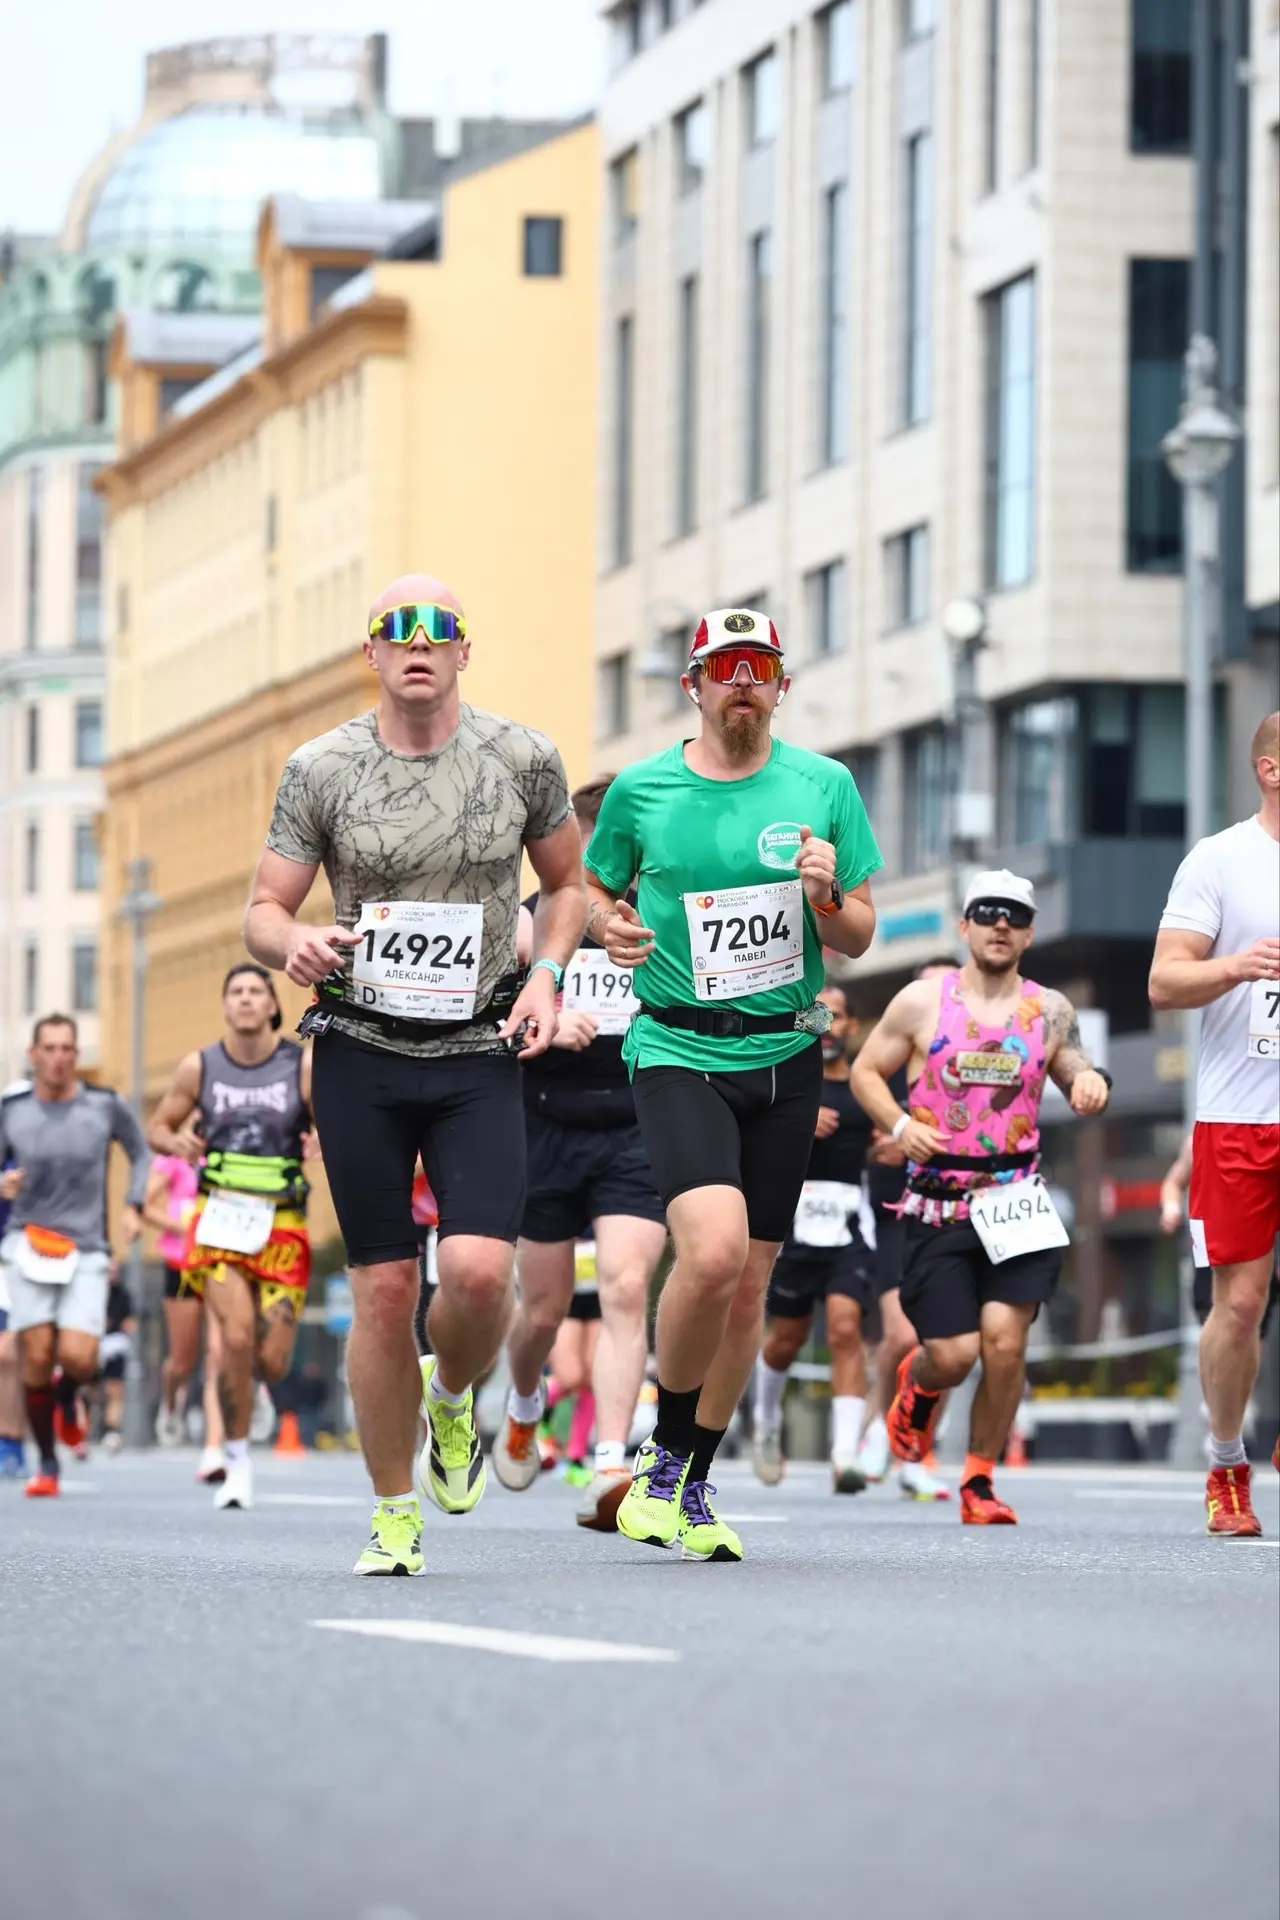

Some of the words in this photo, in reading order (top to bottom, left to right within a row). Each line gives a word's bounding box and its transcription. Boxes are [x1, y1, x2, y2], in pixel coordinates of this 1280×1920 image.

[702, 910, 791, 953] 7204
[362, 929, 475, 970] 14924
[734, 950, 766, 963] ПАВЕЛ
[384, 969, 445, 984] АЛЕКСАНДР
[706, 977, 717, 996] F
[363, 986, 376, 1005] D
[212, 1081, 288, 1113] TWINS
[977, 1194, 1050, 1228] 14494
